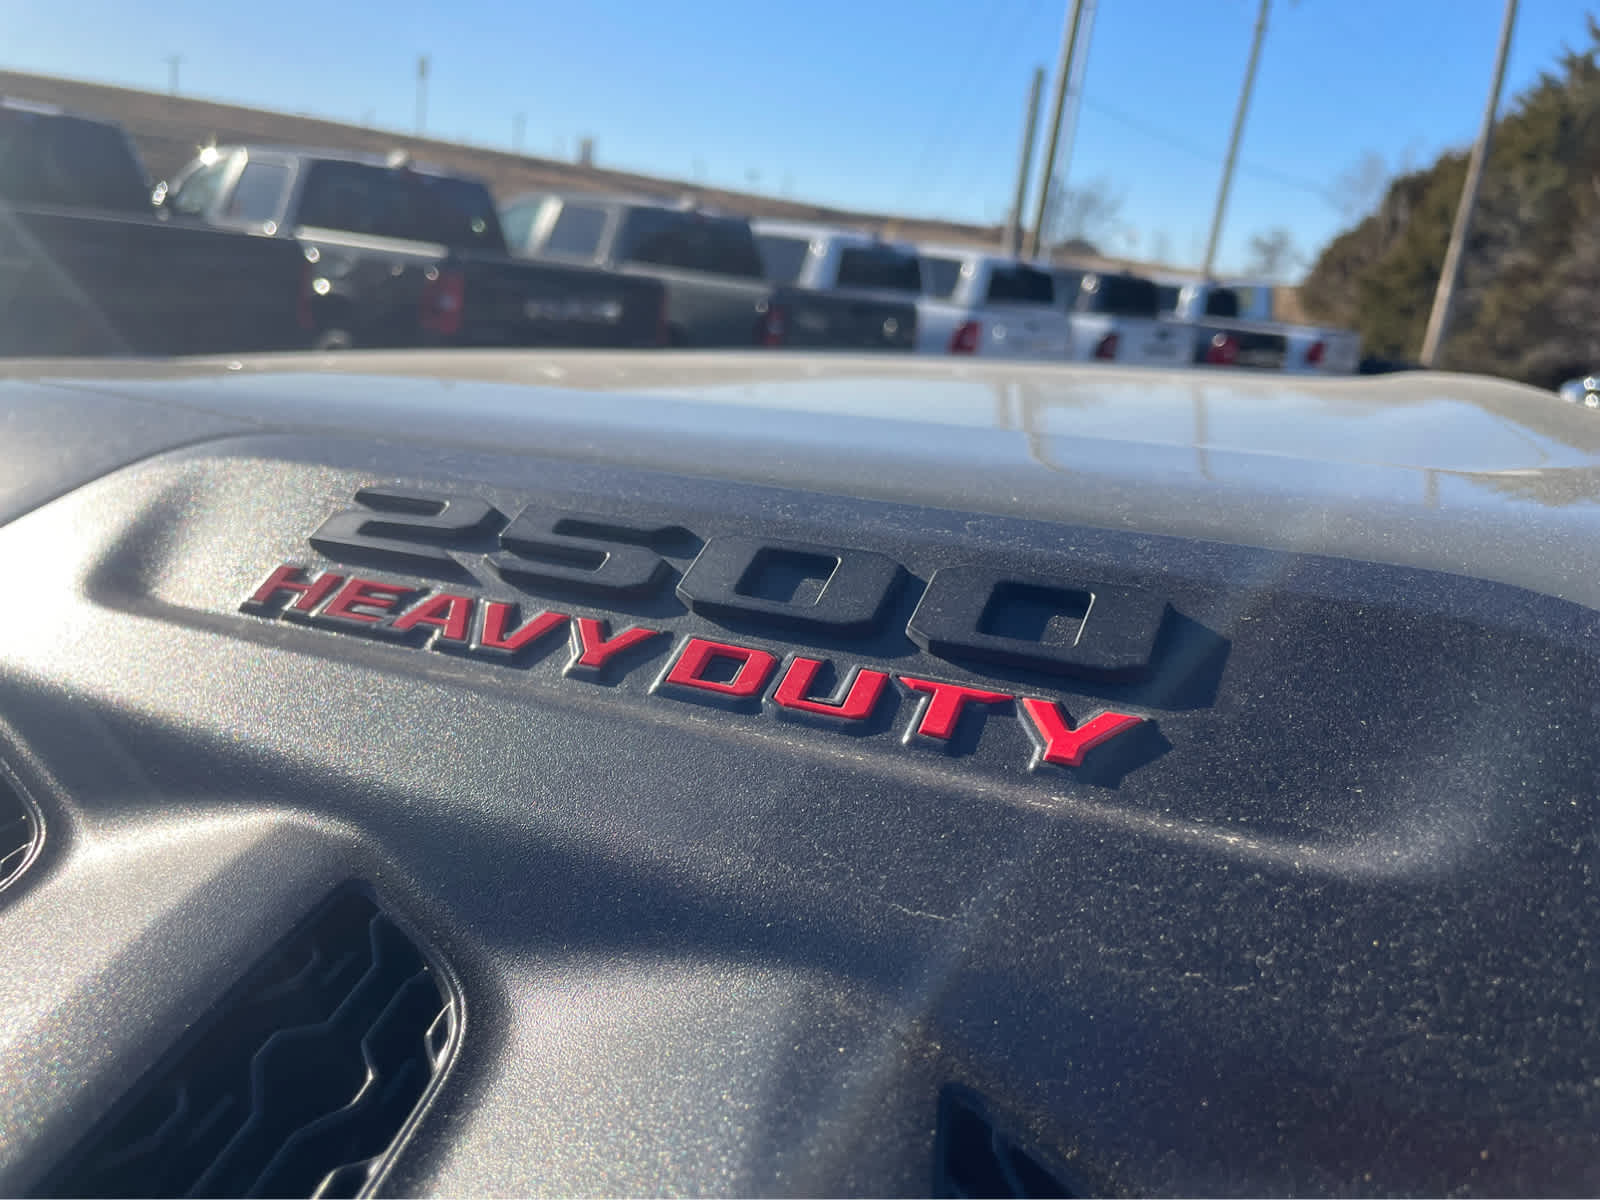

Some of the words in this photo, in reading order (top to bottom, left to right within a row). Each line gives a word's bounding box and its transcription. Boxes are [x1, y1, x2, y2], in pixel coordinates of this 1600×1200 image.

[243, 564, 660, 673] HEAVY
[651, 636, 1147, 769] DUTY
[309, 488, 1170, 680] 2500
